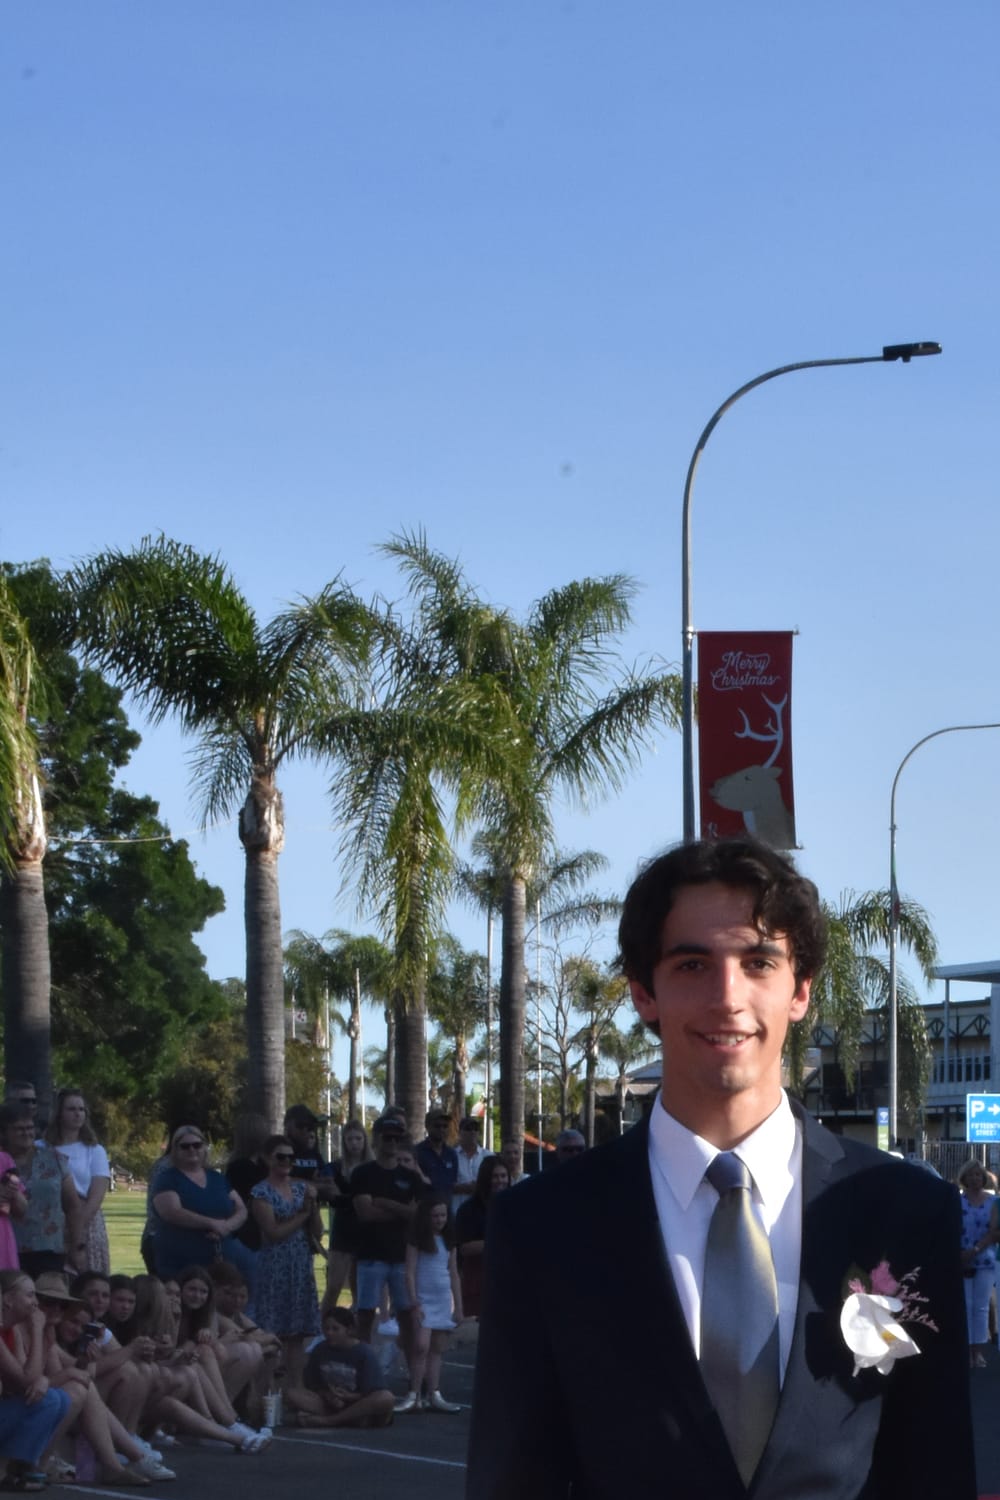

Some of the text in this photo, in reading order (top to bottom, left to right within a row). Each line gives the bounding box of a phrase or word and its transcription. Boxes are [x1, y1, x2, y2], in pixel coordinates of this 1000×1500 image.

[722, 651, 770, 676] Merry
[710, 669, 781, 691] Christmas
[971, 1100, 985, 1118] P
